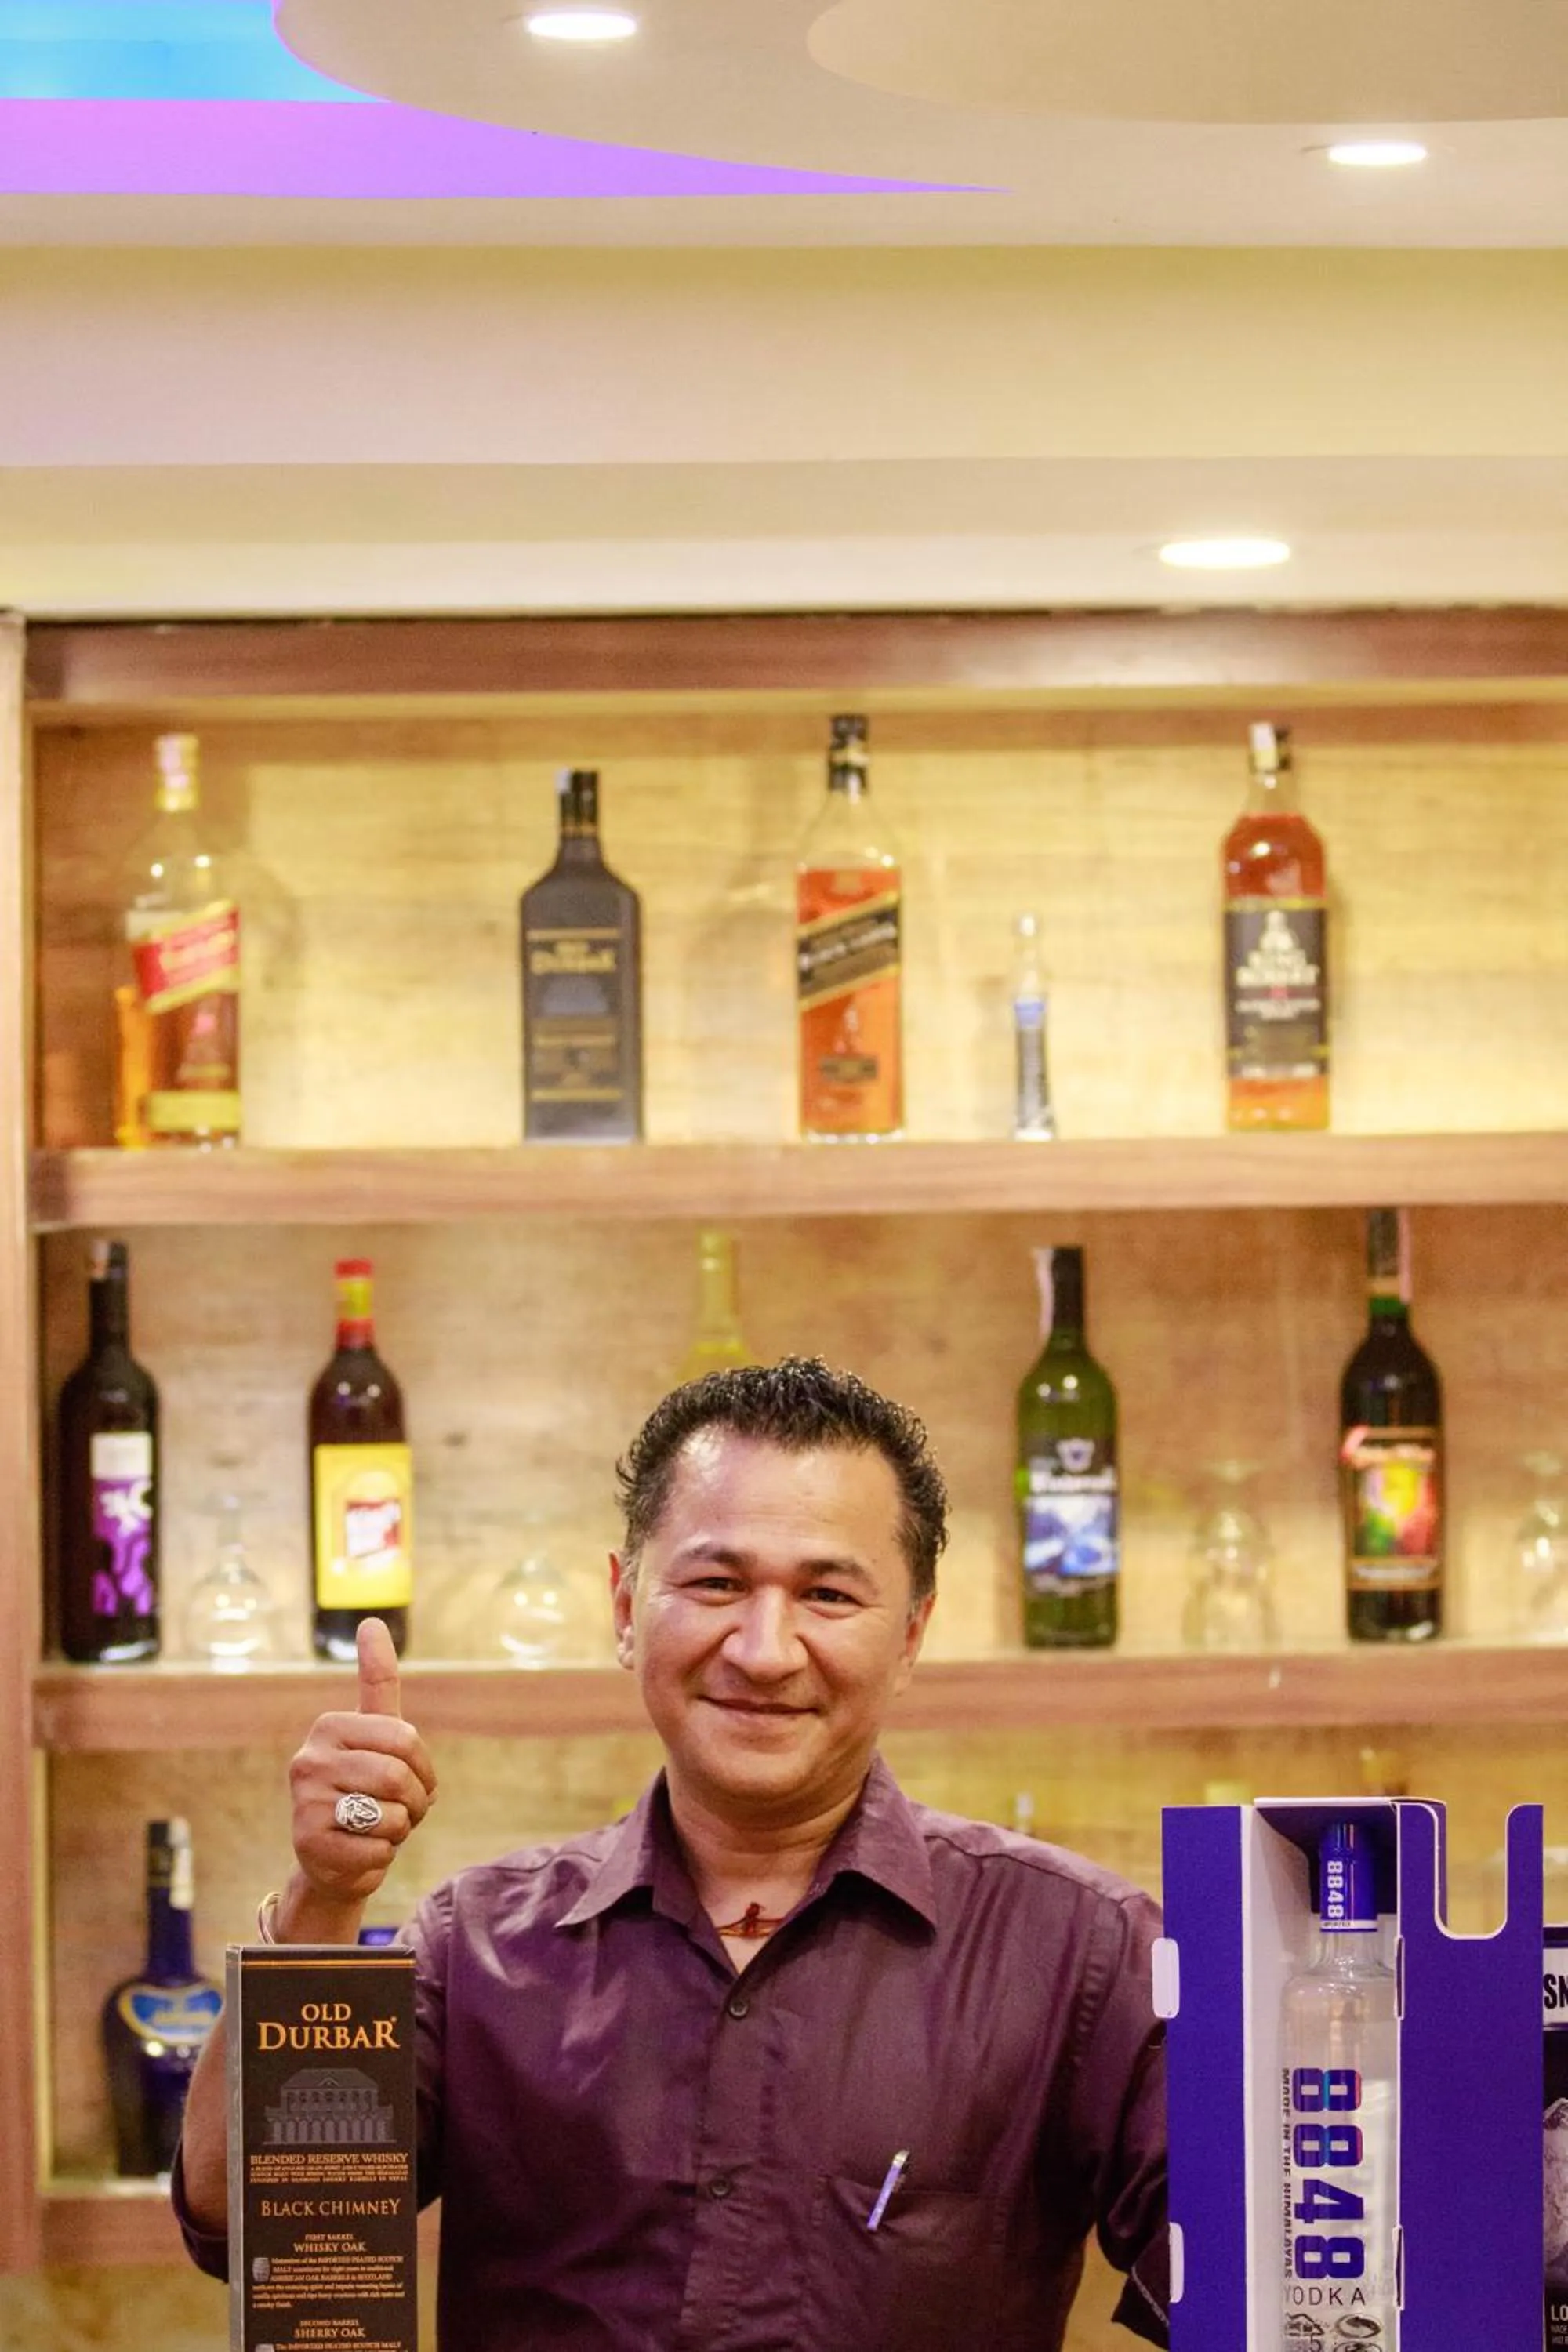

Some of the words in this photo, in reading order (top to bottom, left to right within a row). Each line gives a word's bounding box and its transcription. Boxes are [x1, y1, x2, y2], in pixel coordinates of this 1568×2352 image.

[1327, 1860, 1344, 1918] 8848
[301, 2003, 351, 2022] OLD
[257, 2019, 401, 2050] DURBAR
[1282, 2068, 1291, 2117] MADE
[1283, 2123, 1290, 2140] IN
[250, 2154, 306, 2165] BLENDED
[307, 2154, 360, 2165] RESERVE
[361, 2153, 408, 2164] WHISKY
[1292, 2067, 1364, 2279] 8848
[261, 2199, 314, 2217] BLACK
[318, 2198, 401, 2216] CHIMNEY
[1284, 2182, 1293, 2278] HIMALAYAS
[293, 2242, 339, 2253] WHISKY
[341, 2241, 367, 2252] OAK
[294, 2327, 338, 2339] SHERRY
[340, 2327, 366, 2338] OAK
